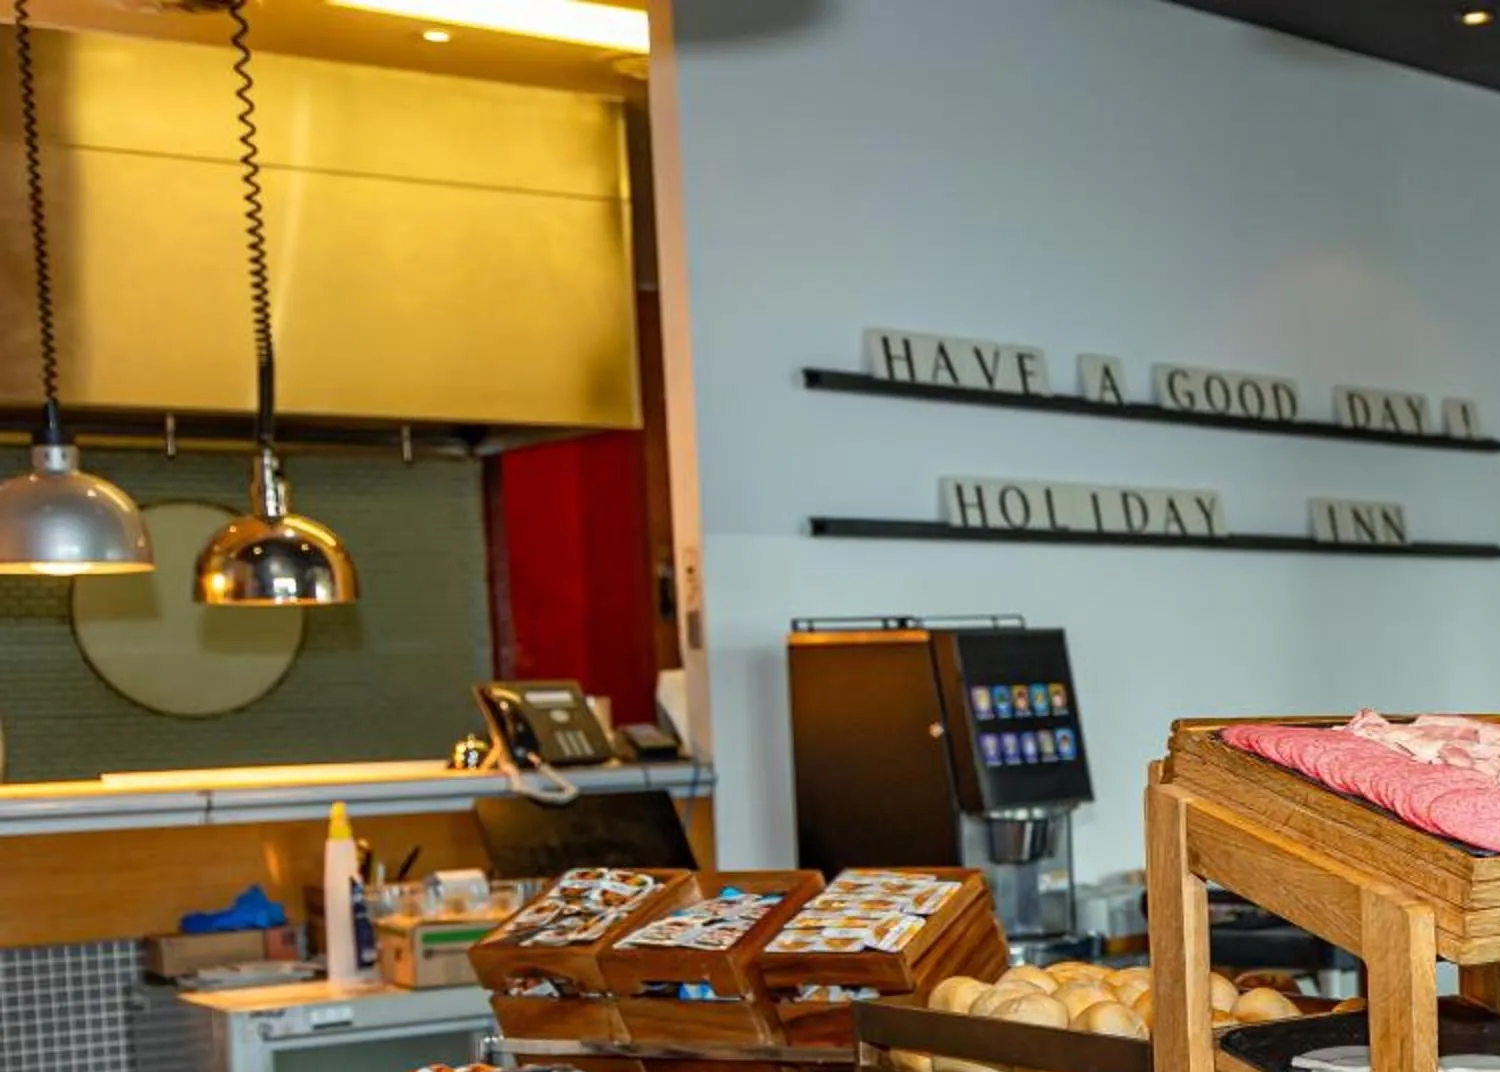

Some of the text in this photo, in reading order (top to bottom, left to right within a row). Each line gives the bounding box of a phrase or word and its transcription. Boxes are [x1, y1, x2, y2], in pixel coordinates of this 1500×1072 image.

[881, 334, 1038, 396] HAVE
[1098, 362, 1123, 407] A
[1166, 368, 1298, 421] GOOD
[1345, 391, 1428, 436] DAY
[954, 483, 1407, 543] HOLIDAY INN
